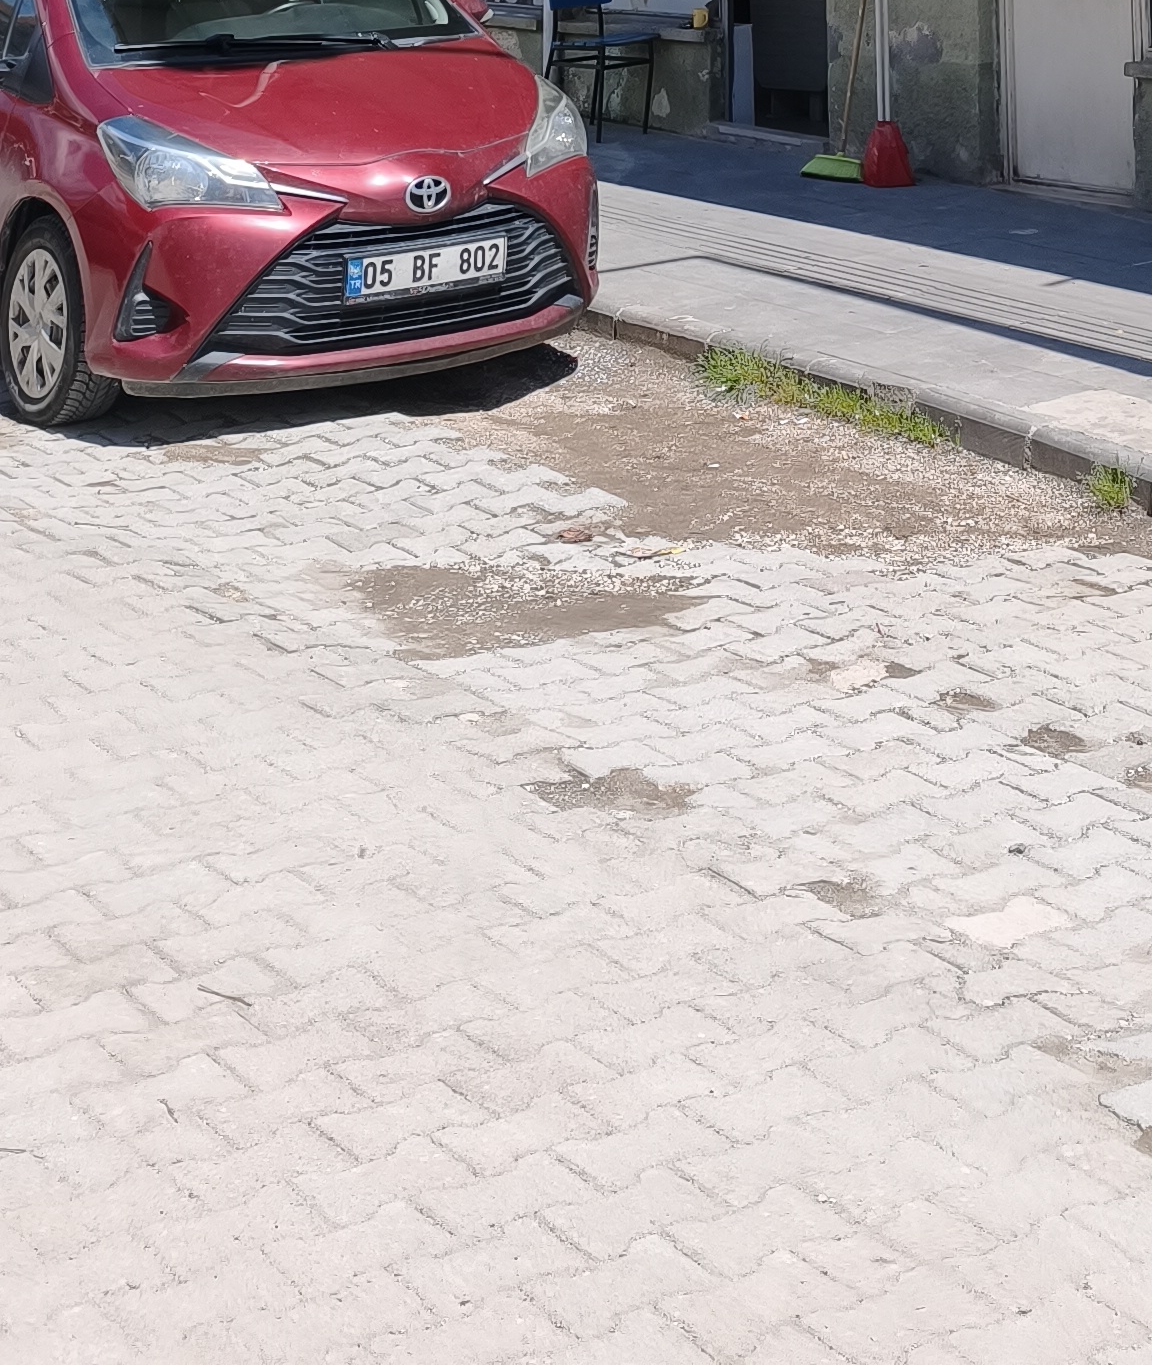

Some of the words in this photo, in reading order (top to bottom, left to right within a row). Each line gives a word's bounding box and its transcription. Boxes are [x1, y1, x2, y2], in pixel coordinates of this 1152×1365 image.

[350, 279, 361, 290] TR
[363, 259, 394, 289] 05
[412, 252, 441, 283] BF
[460, 243, 500, 275] 802
